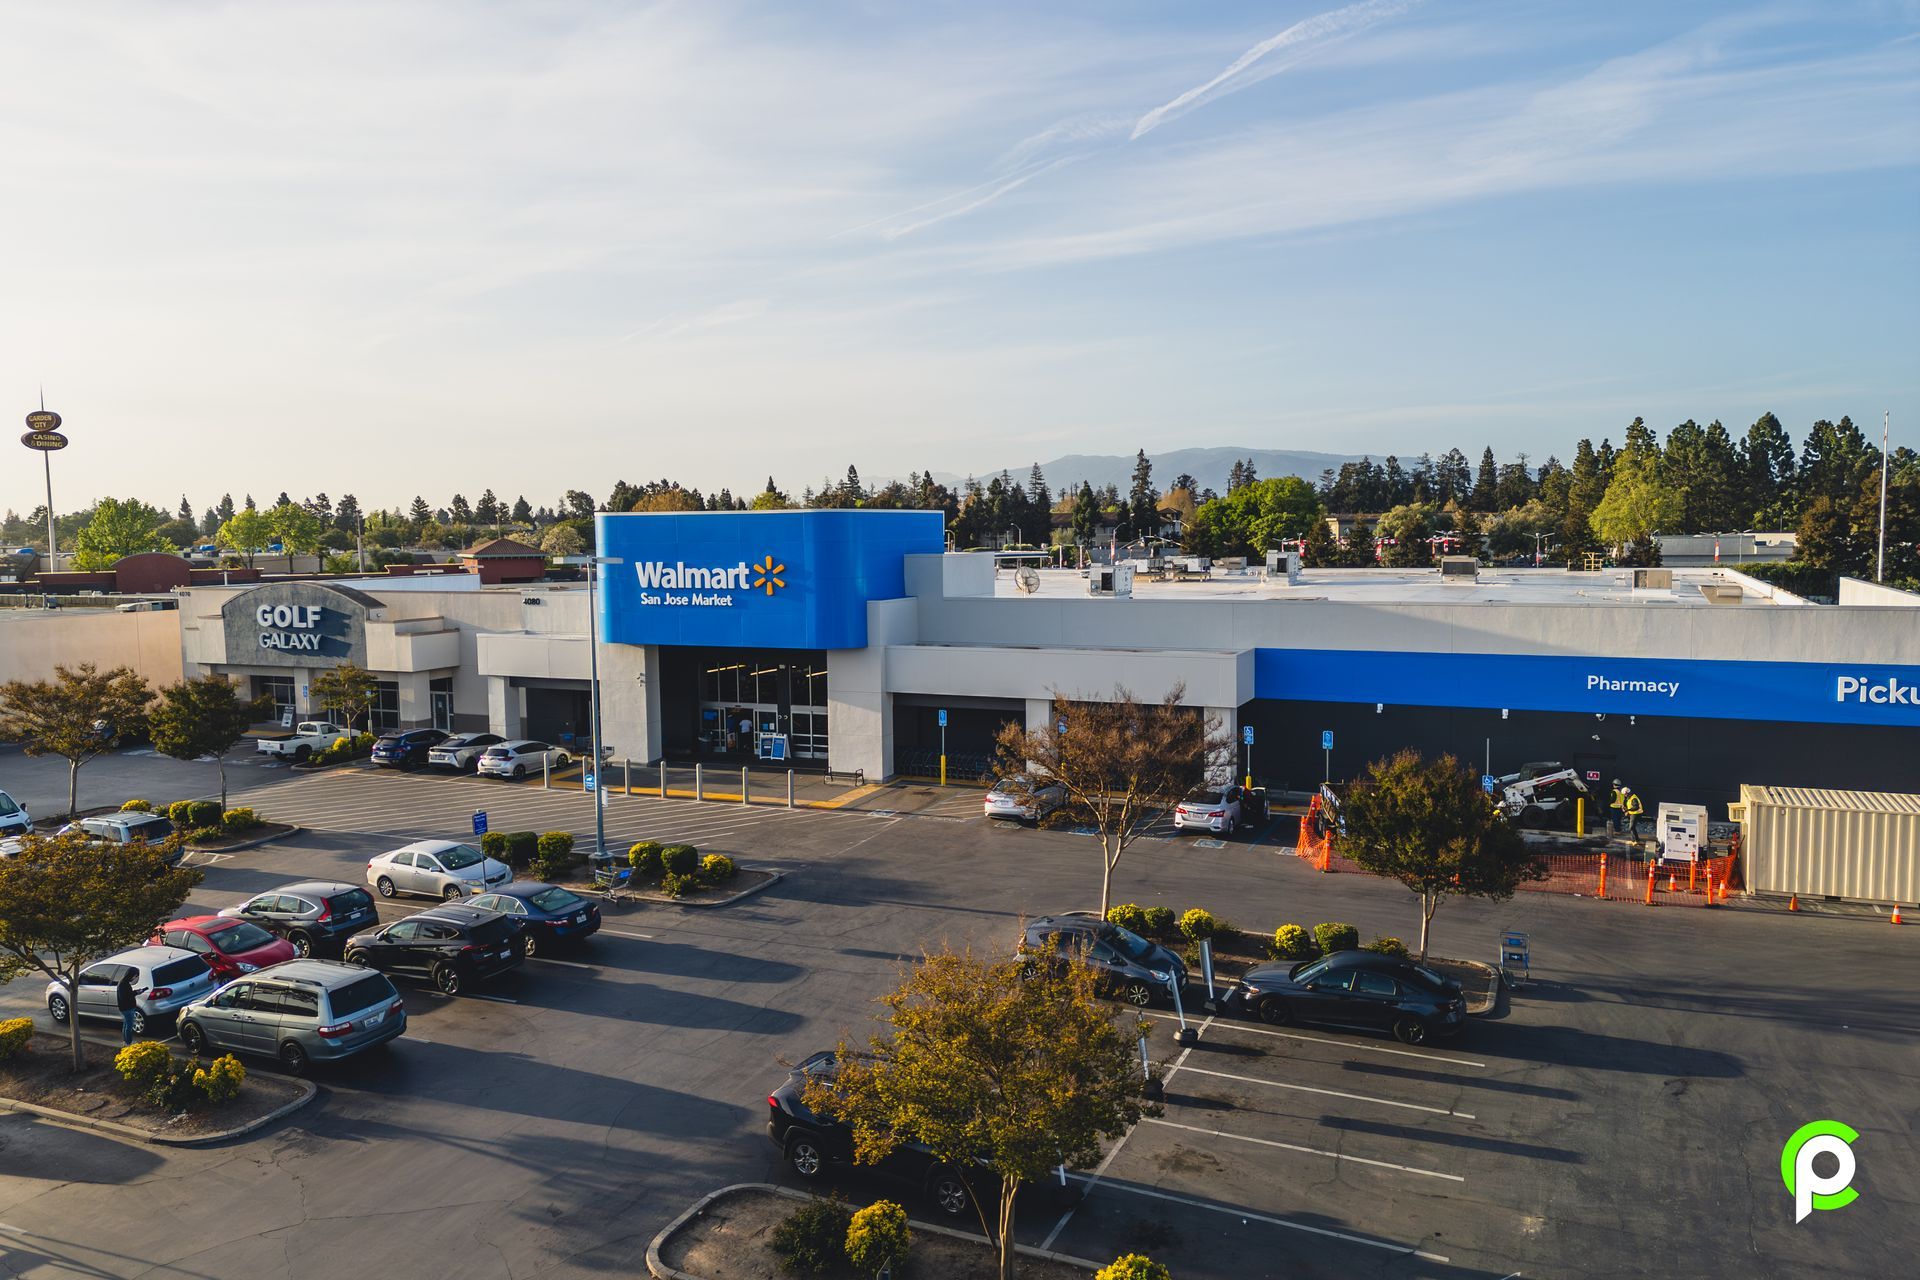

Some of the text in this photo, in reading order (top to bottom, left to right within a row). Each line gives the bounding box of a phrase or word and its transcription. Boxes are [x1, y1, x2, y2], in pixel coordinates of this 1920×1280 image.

[634, 561, 750, 590] Walmart
[640, 592, 733, 607] San Jose Market
[256, 604, 322, 628] GOLF
[259, 632, 321, 650] GALAXY
[1587, 675, 1680, 697] Pharmacy
